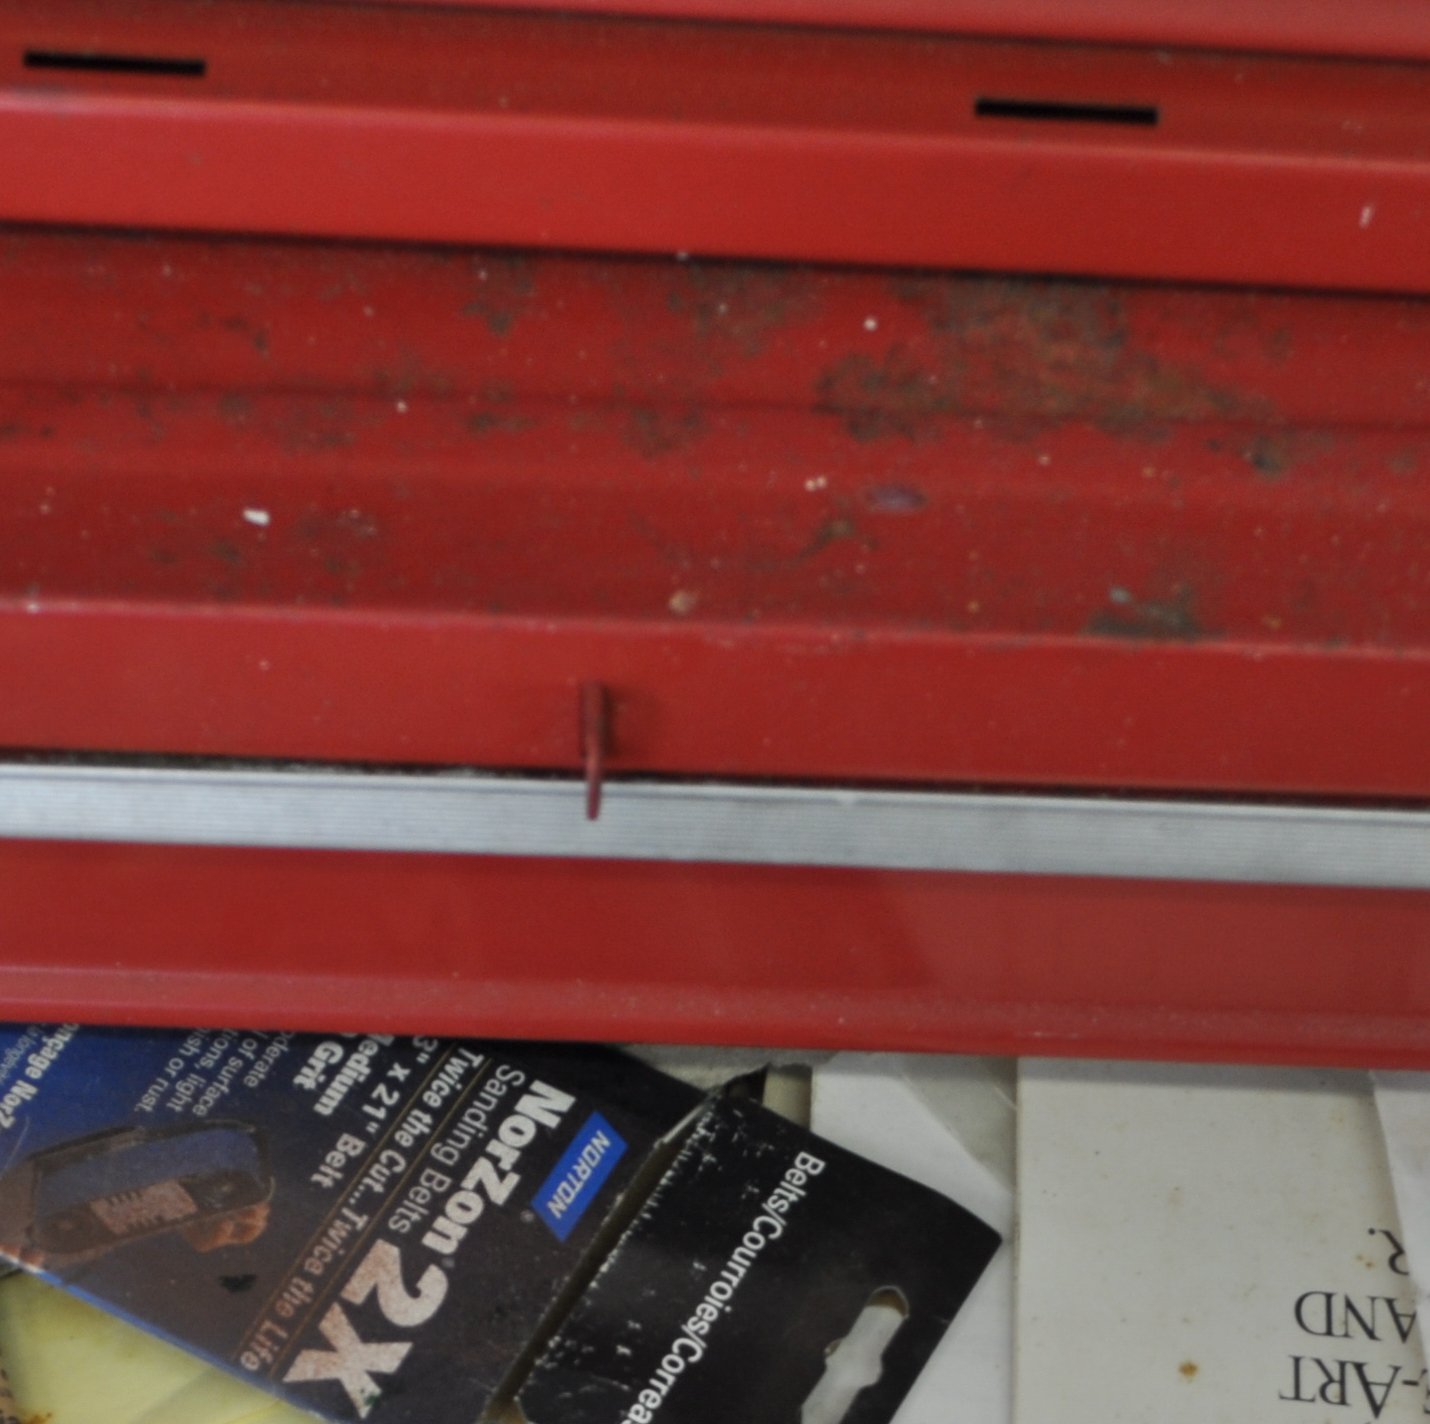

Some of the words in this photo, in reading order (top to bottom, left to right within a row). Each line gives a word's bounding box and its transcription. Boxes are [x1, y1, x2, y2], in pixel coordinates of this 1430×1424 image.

[172, 1072, 209, 1113] light
[191, 1056, 243, 1117] surface
[292, 1040, 345, 1090] Grit
[427, 1046, 485, 1107] Twice
[394, 1104, 435, 1146] the
[428, 1062, 527, 1167] Sanding
[310, 1132, 365, 1190] Belt
[546, 1129, 613, 1220] NORTON
[387, 1167, 453, 1234] Belts
[275, 1278, 316, 1320] the
[283, 1239, 449, 1420] 2X
